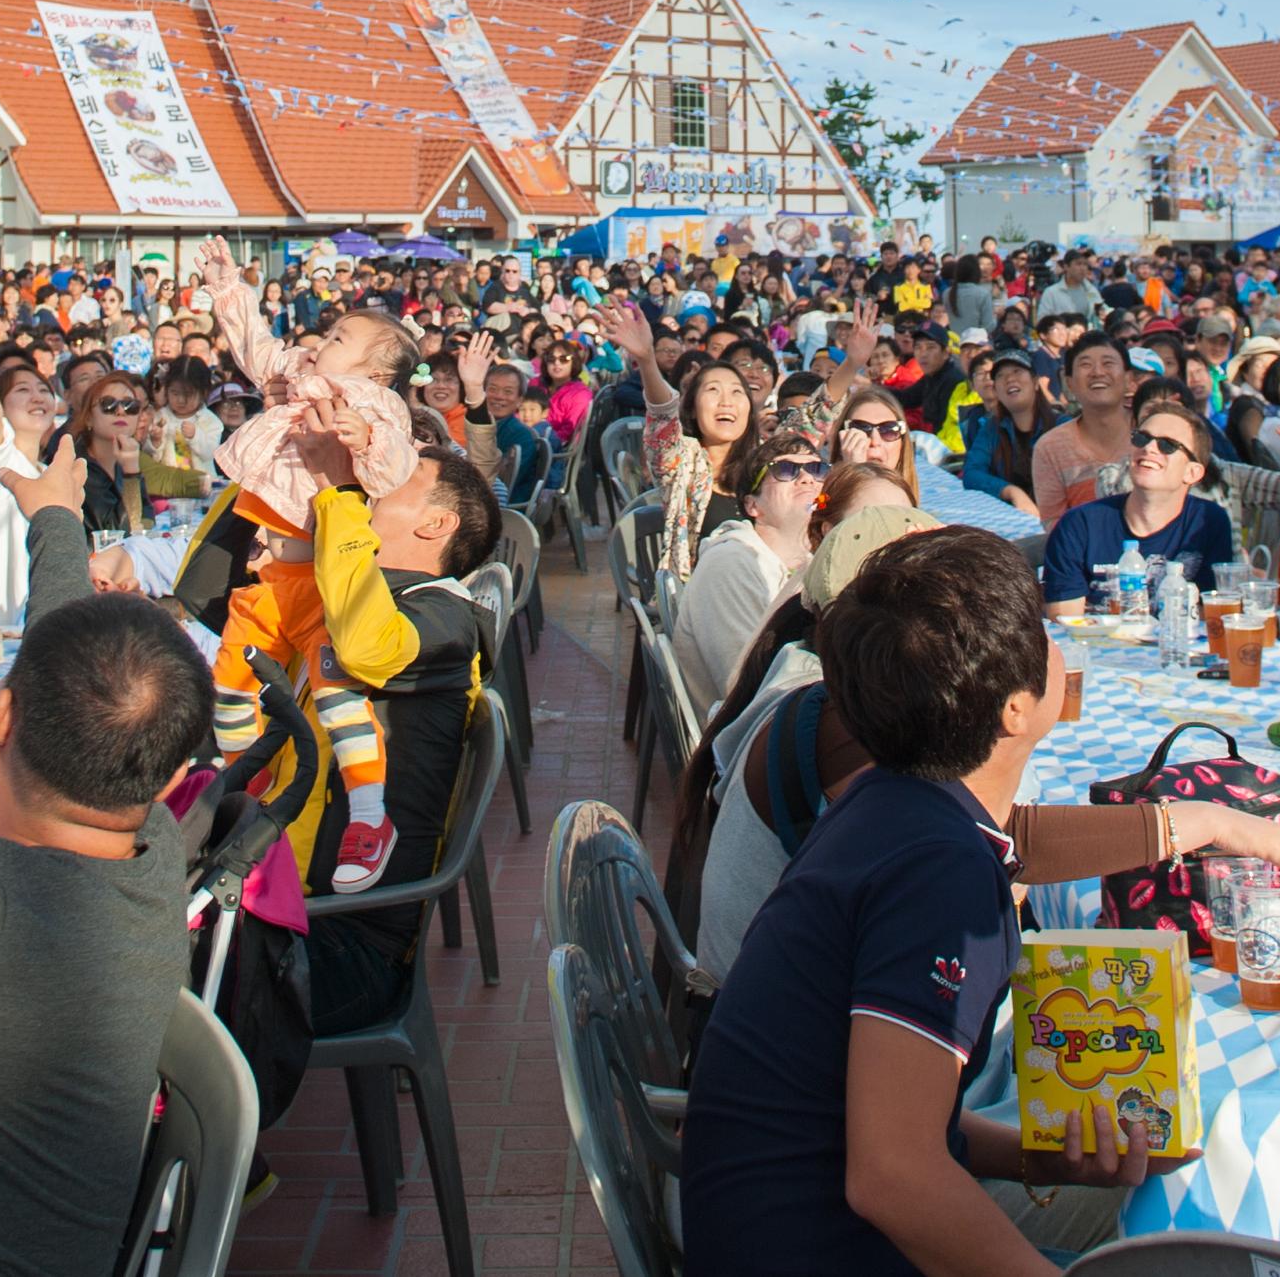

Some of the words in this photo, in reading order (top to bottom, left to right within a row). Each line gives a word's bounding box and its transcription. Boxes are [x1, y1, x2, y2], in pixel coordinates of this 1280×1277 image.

[639, 158, 777, 205] Bayreuth
[1103, 958, 1151, 987] 팝콘
[1028, 1013, 1165, 1063] Popcorn
